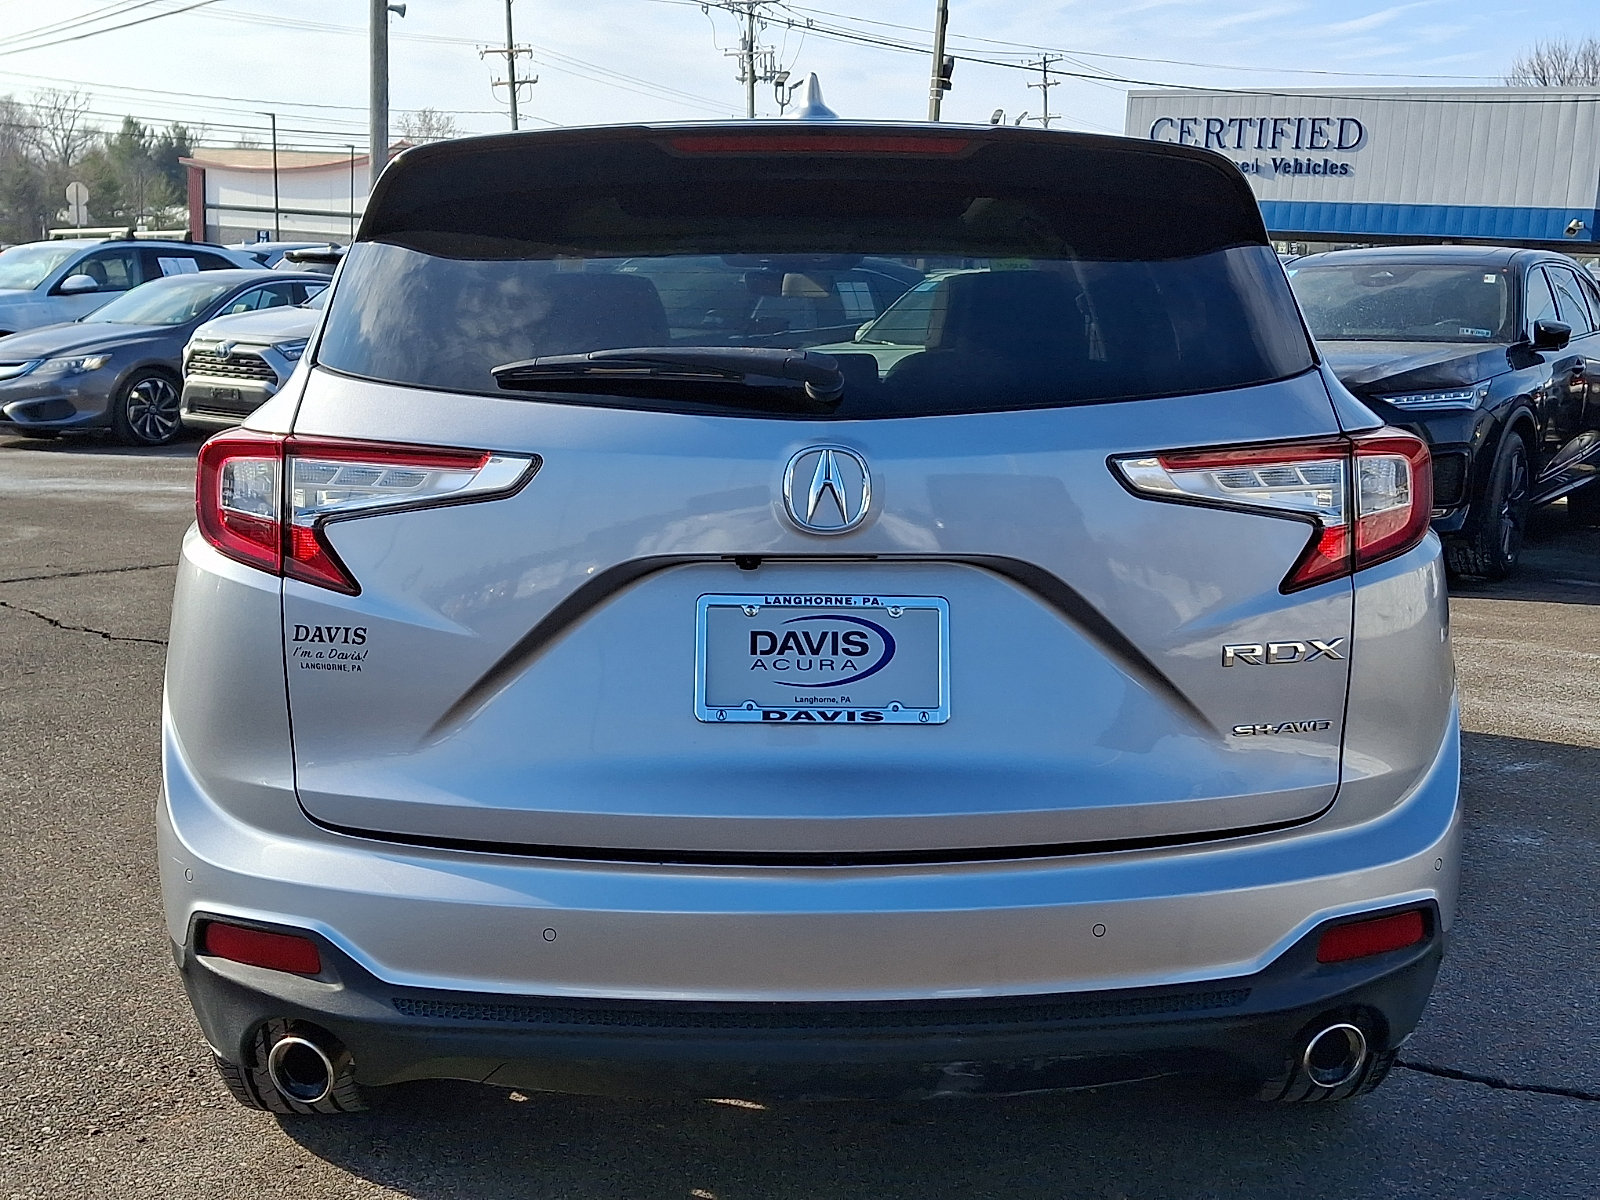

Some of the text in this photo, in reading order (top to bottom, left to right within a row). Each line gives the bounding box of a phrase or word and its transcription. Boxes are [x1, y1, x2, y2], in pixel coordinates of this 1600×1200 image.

[1150, 117, 1364, 150] CERTIFIED
[1271, 157, 1349, 175] Vehicles
[764, 596, 884, 607] LANGHORNE, PA.
[292, 624, 367, 645] DAVIS
[750, 630, 869, 657] DAVIS
[1222, 636, 1345, 667] RDX
[293, 646, 369, 662] I'm a Davis!
[351, 664, 362, 673] PA
[751, 659, 858, 671] ACURA
[794, 696, 851, 704] Langhorne, PA
[762, 710, 885, 722] DAVIS
